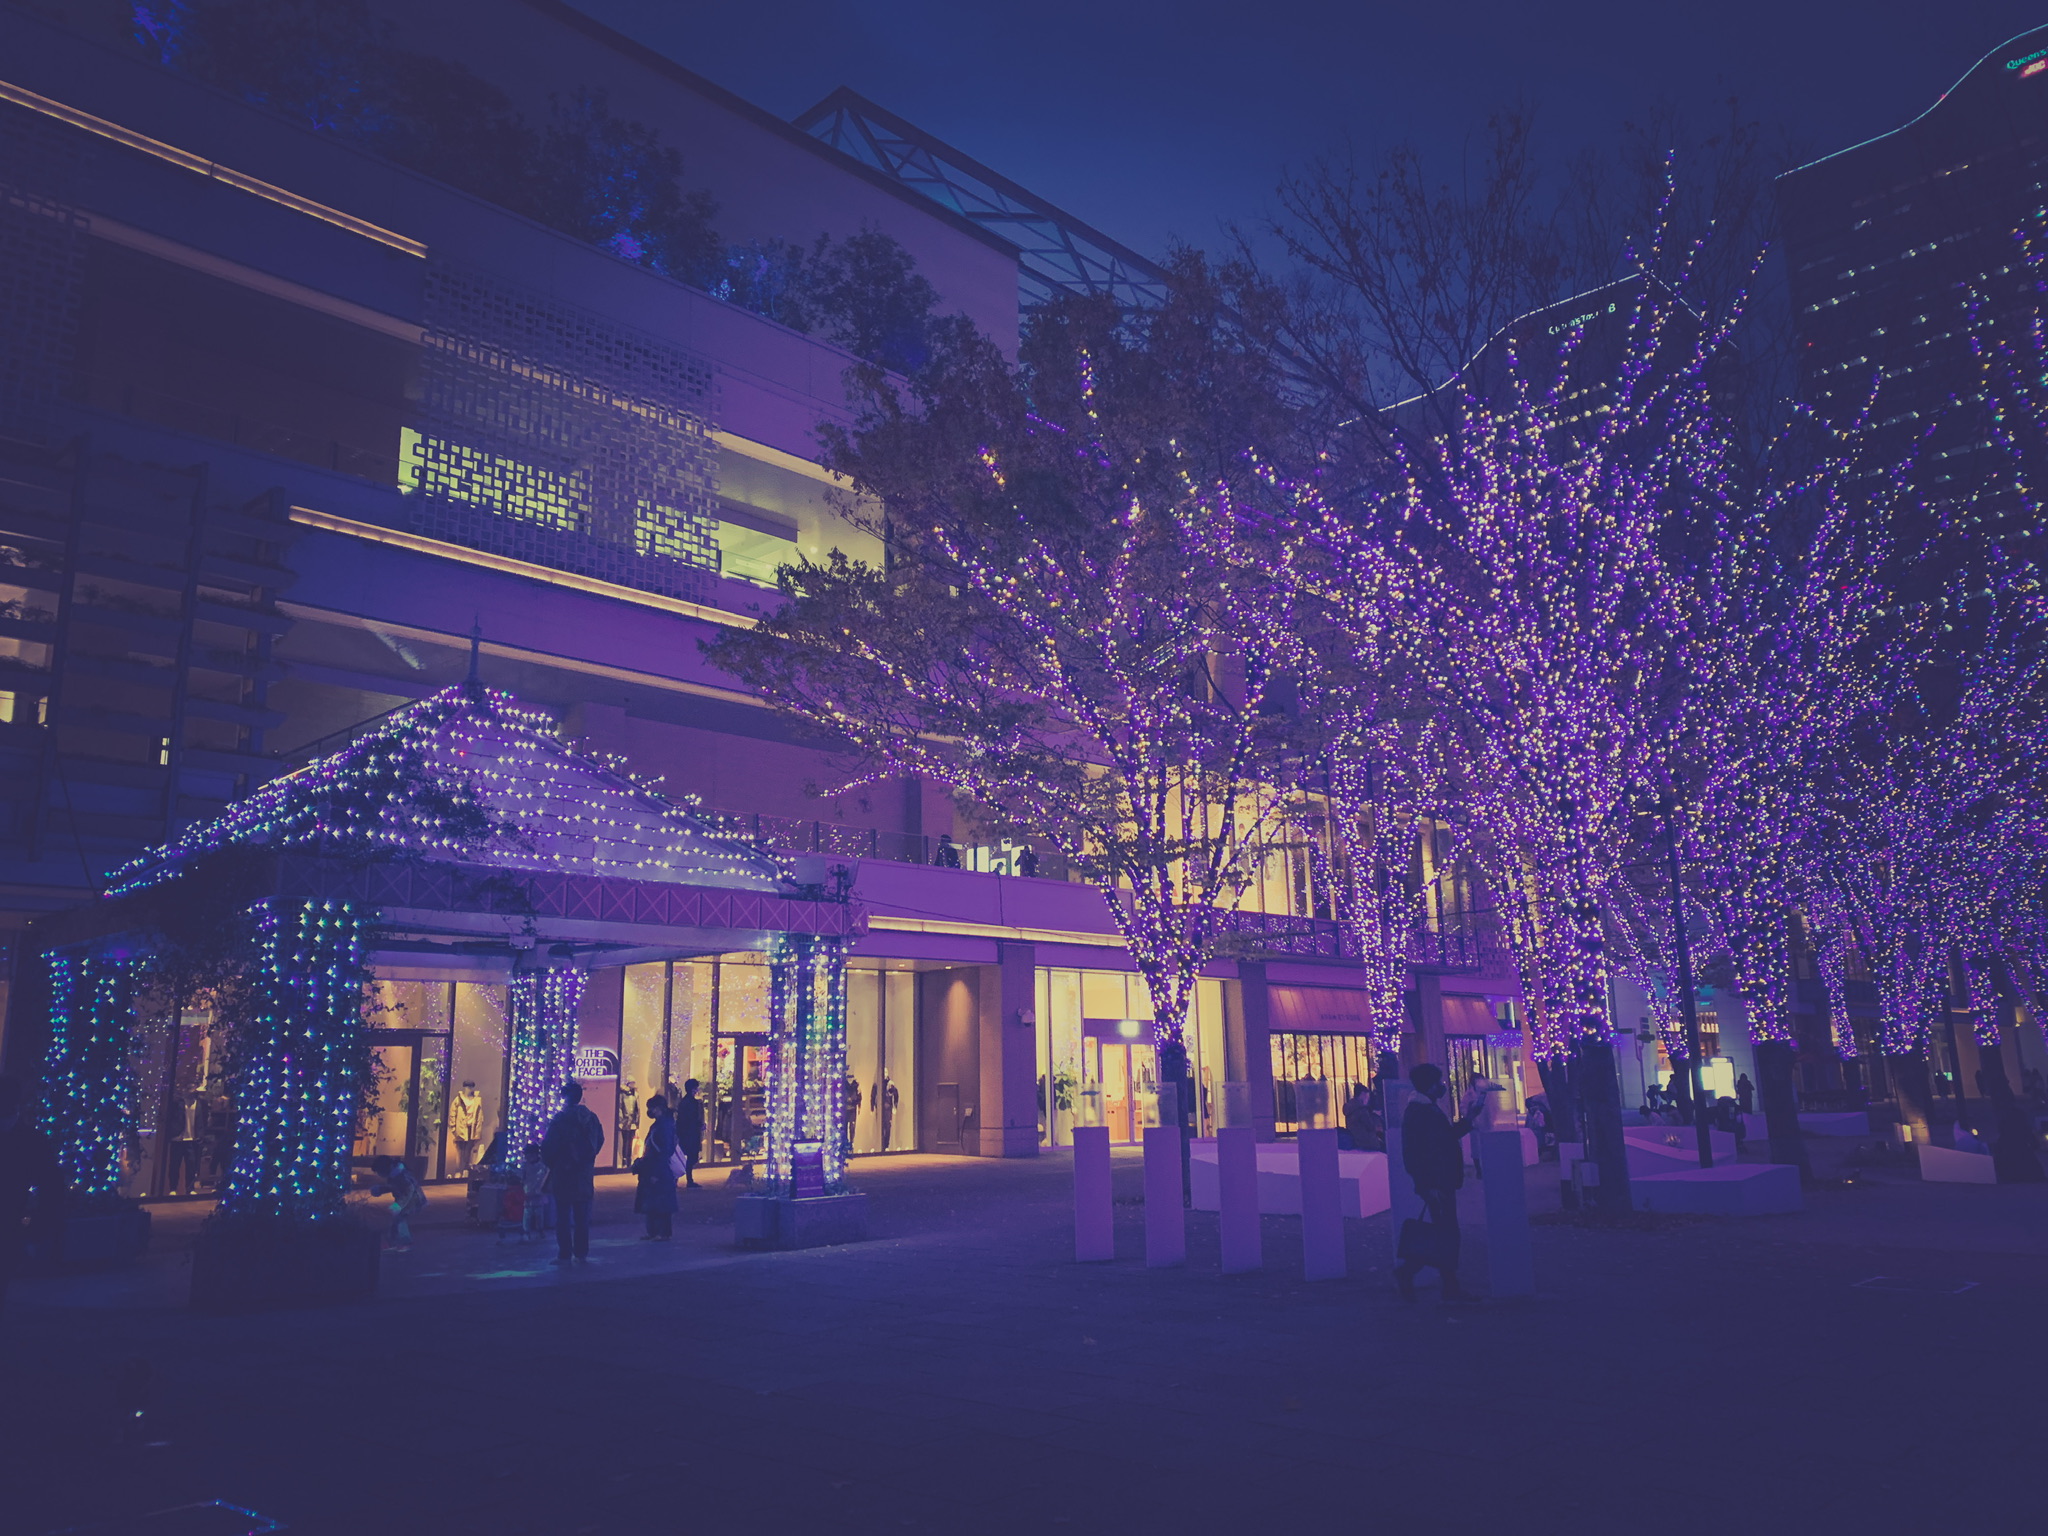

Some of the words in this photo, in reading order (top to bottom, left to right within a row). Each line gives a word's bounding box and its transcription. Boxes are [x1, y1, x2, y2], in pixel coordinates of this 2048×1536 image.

[584, 1049, 604, 1058] THE
[574, 1058, 603, 1067] ORTH
[578, 1067, 604, 1077] FACE
